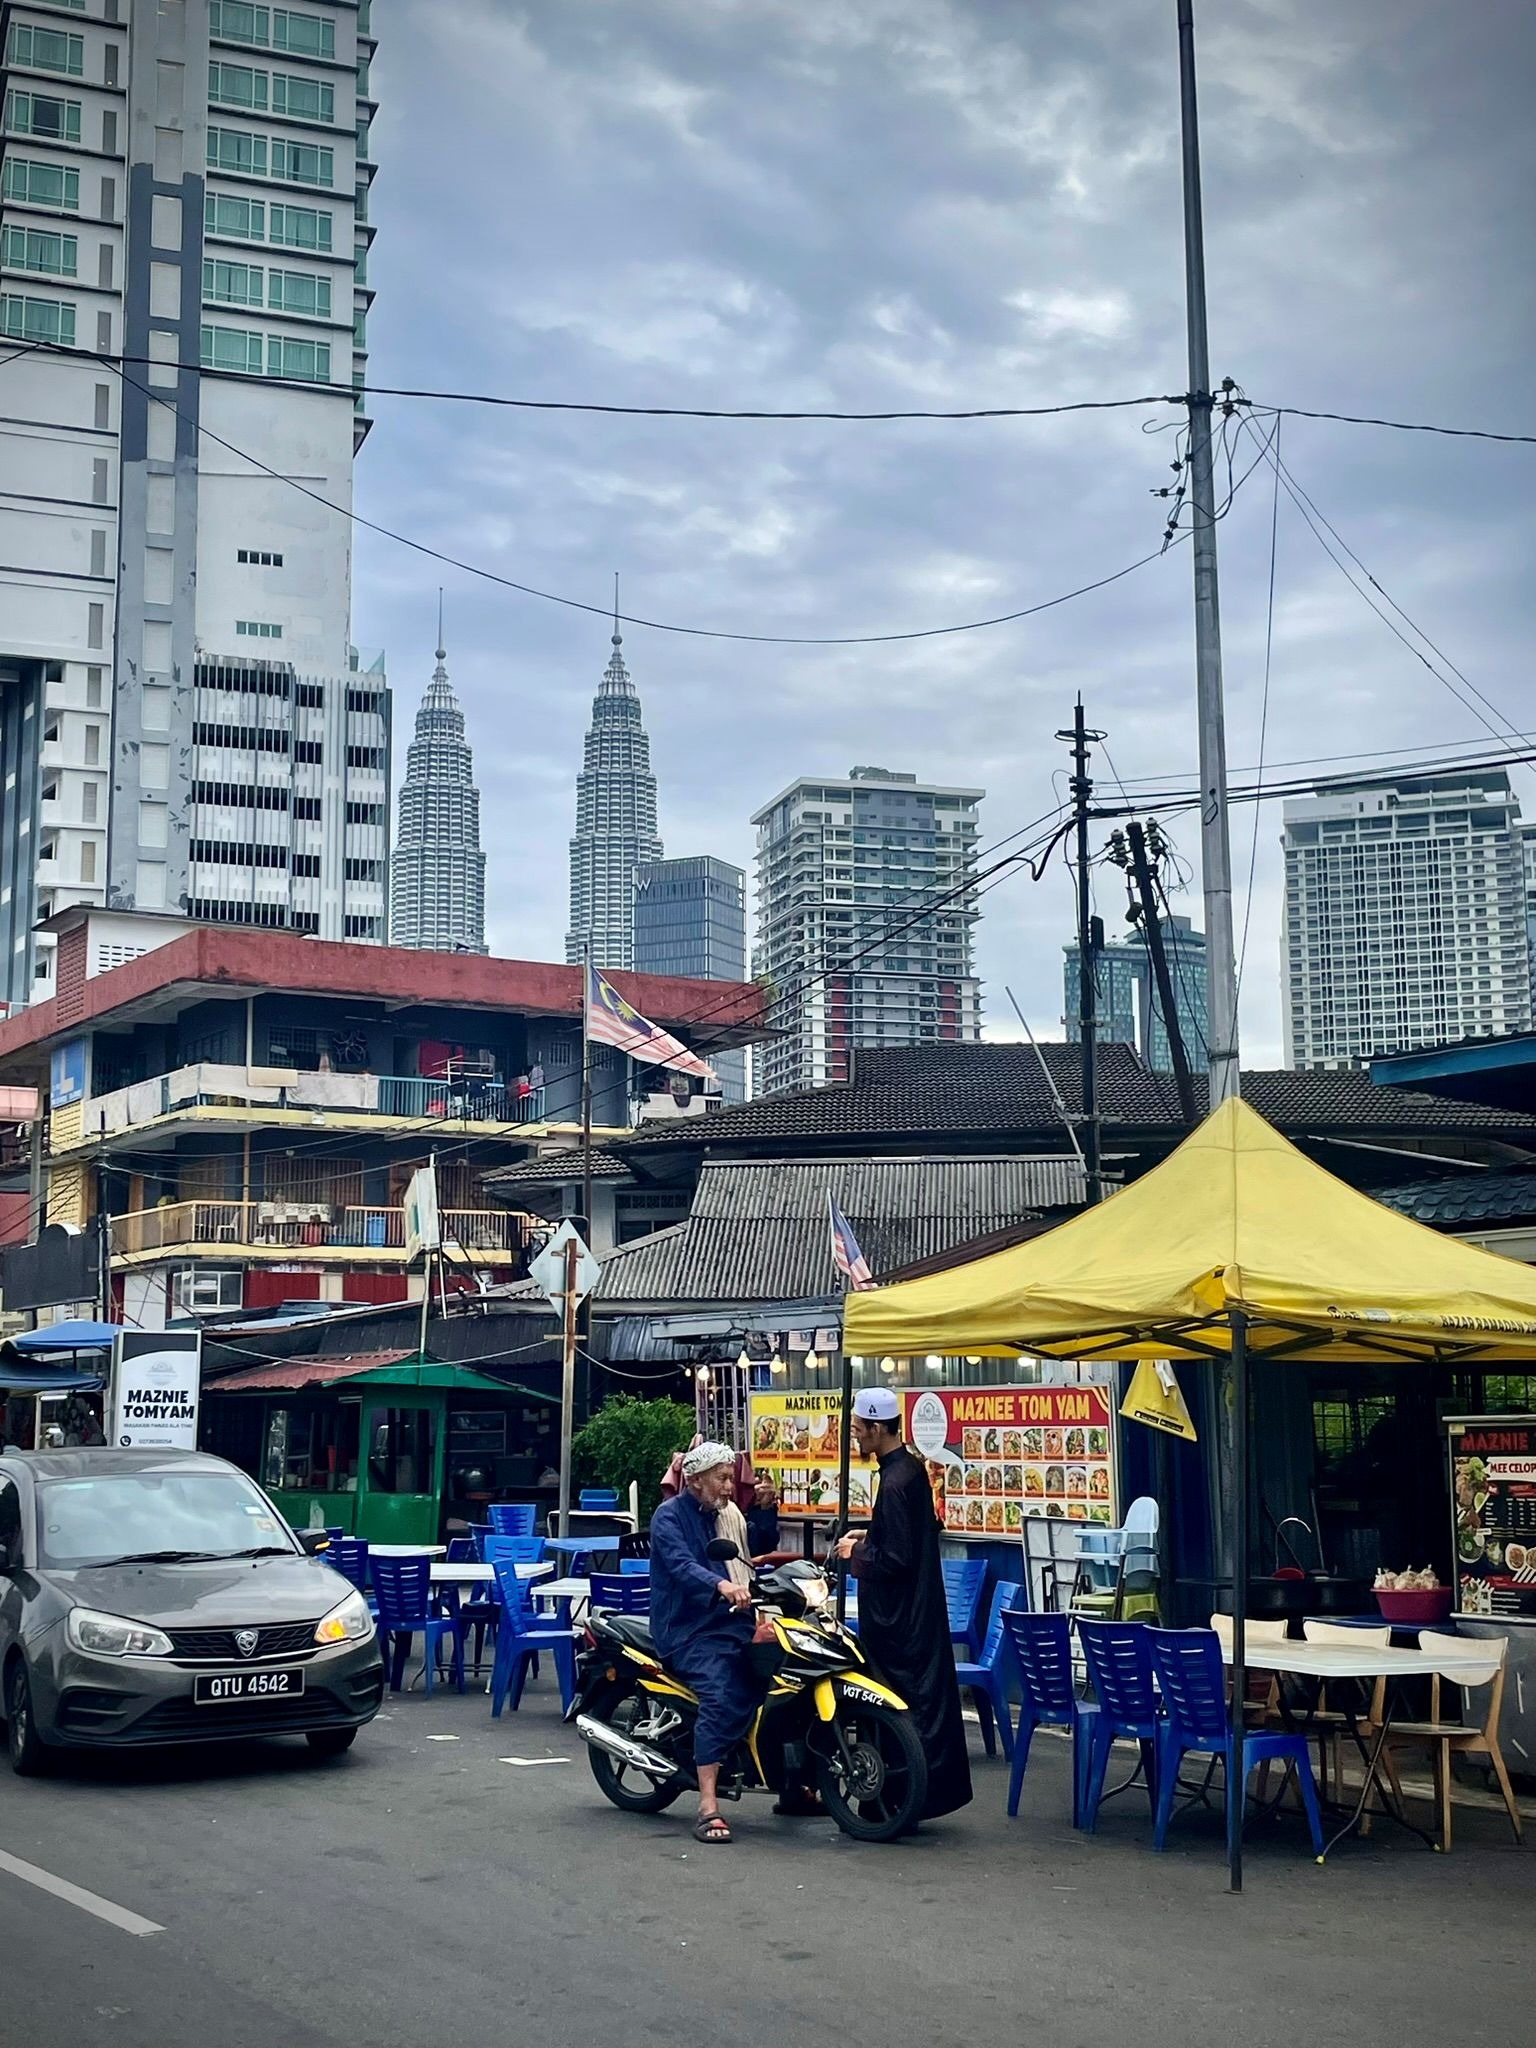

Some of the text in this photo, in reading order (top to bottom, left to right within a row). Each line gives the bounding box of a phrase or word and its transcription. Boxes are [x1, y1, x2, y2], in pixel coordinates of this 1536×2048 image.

[635, 877, 651, 891] W
[1440, 1315, 1475, 1330] BAZAR
[1475, 1317, 1524, 1334] RAMADAN
[127, 1389, 189, 1404] MAZNIE
[785, 1396, 821, 1410] MAZNEE
[123, 1405, 195, 1419] TOMYAM
[952, 1394, 1091, 1422] MAZNEE TOM YAM
[1460, 1432, 1529, 1451] MAZNIE
[1490, 1463, 1508, 1473] MEE
[211, 1673, 289, 1697] QTU 4542
[843, 1684, 885, 1706] VGT 5472
